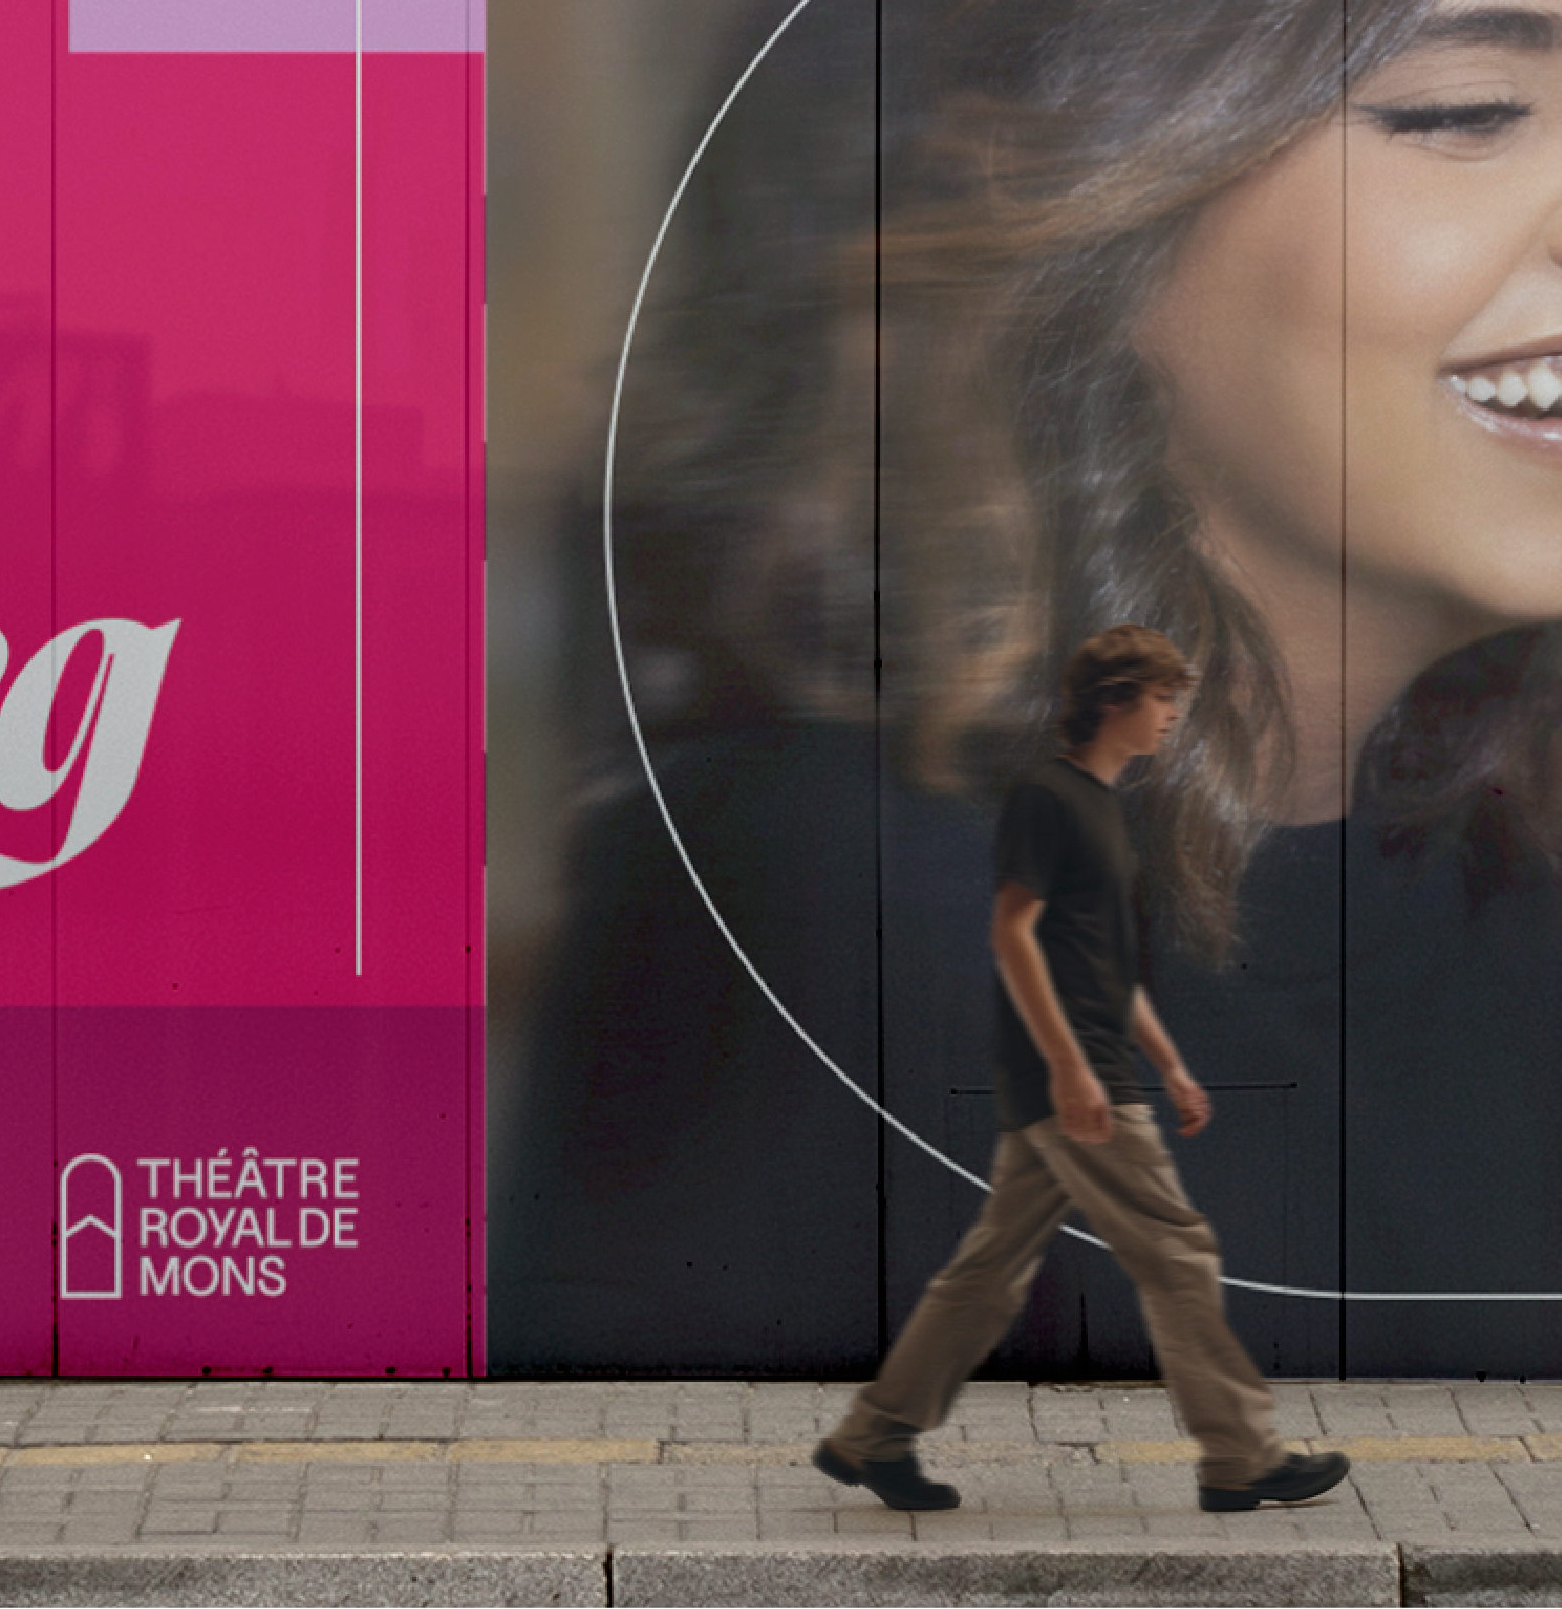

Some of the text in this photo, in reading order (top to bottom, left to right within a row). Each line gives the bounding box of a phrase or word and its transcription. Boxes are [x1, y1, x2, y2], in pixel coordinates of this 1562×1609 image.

[136, 1146, 360, 1198] THÉÂTRE
[140, 1207, 360, 1249] ROYAL DE
[140, 1255, 288, 1297] MONS
